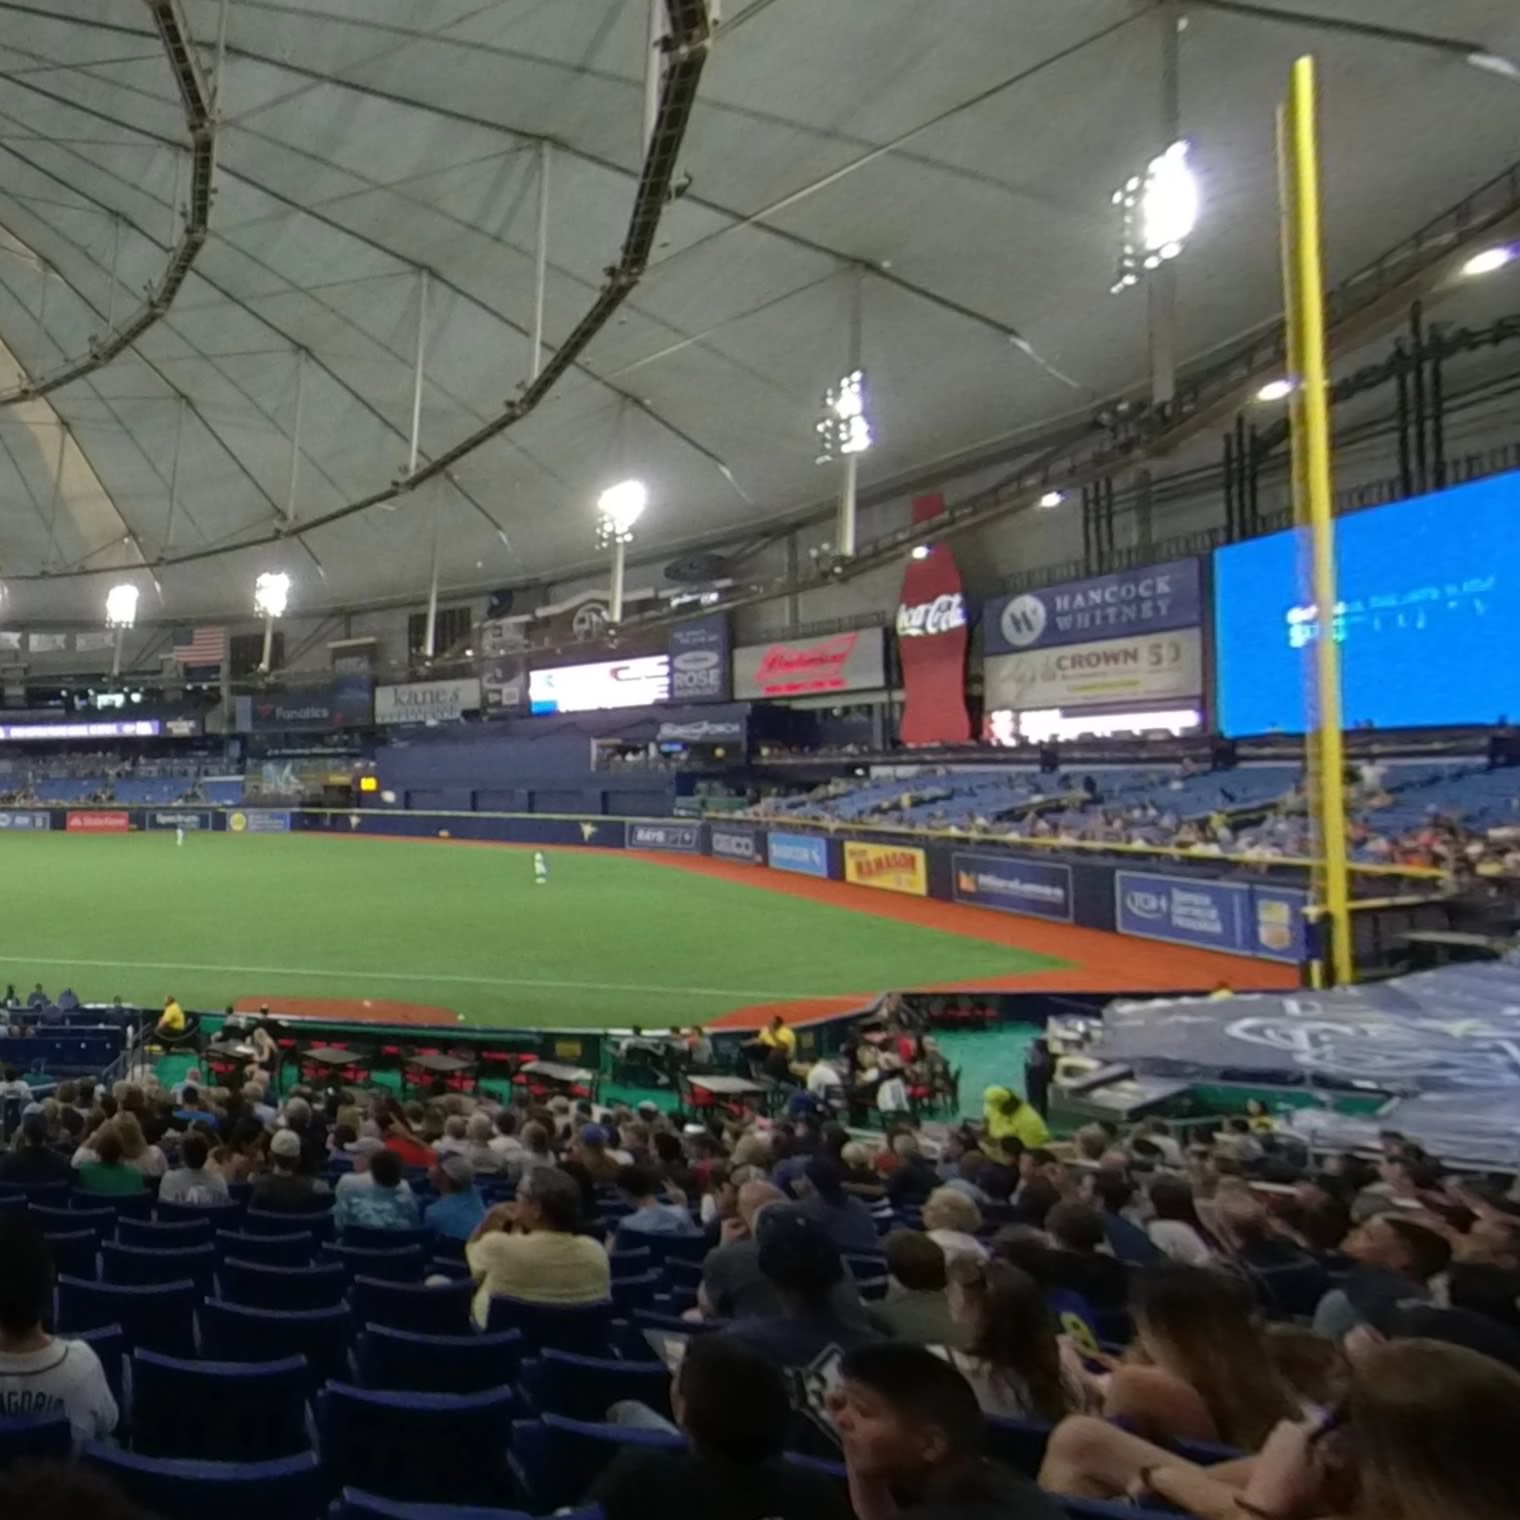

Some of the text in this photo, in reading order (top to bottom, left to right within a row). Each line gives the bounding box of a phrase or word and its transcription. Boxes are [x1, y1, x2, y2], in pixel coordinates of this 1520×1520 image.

[1055, 573, 1172, 612] HANCOCK
[1055, 599, 1172, 632] WHITNEY
[1055, 648, 1138, 672] CROWN
[673, 668, 721, 689] ROSE
[275, 706, 329, 720] Fanatics
[712, 832, 754, 856] GEICO
